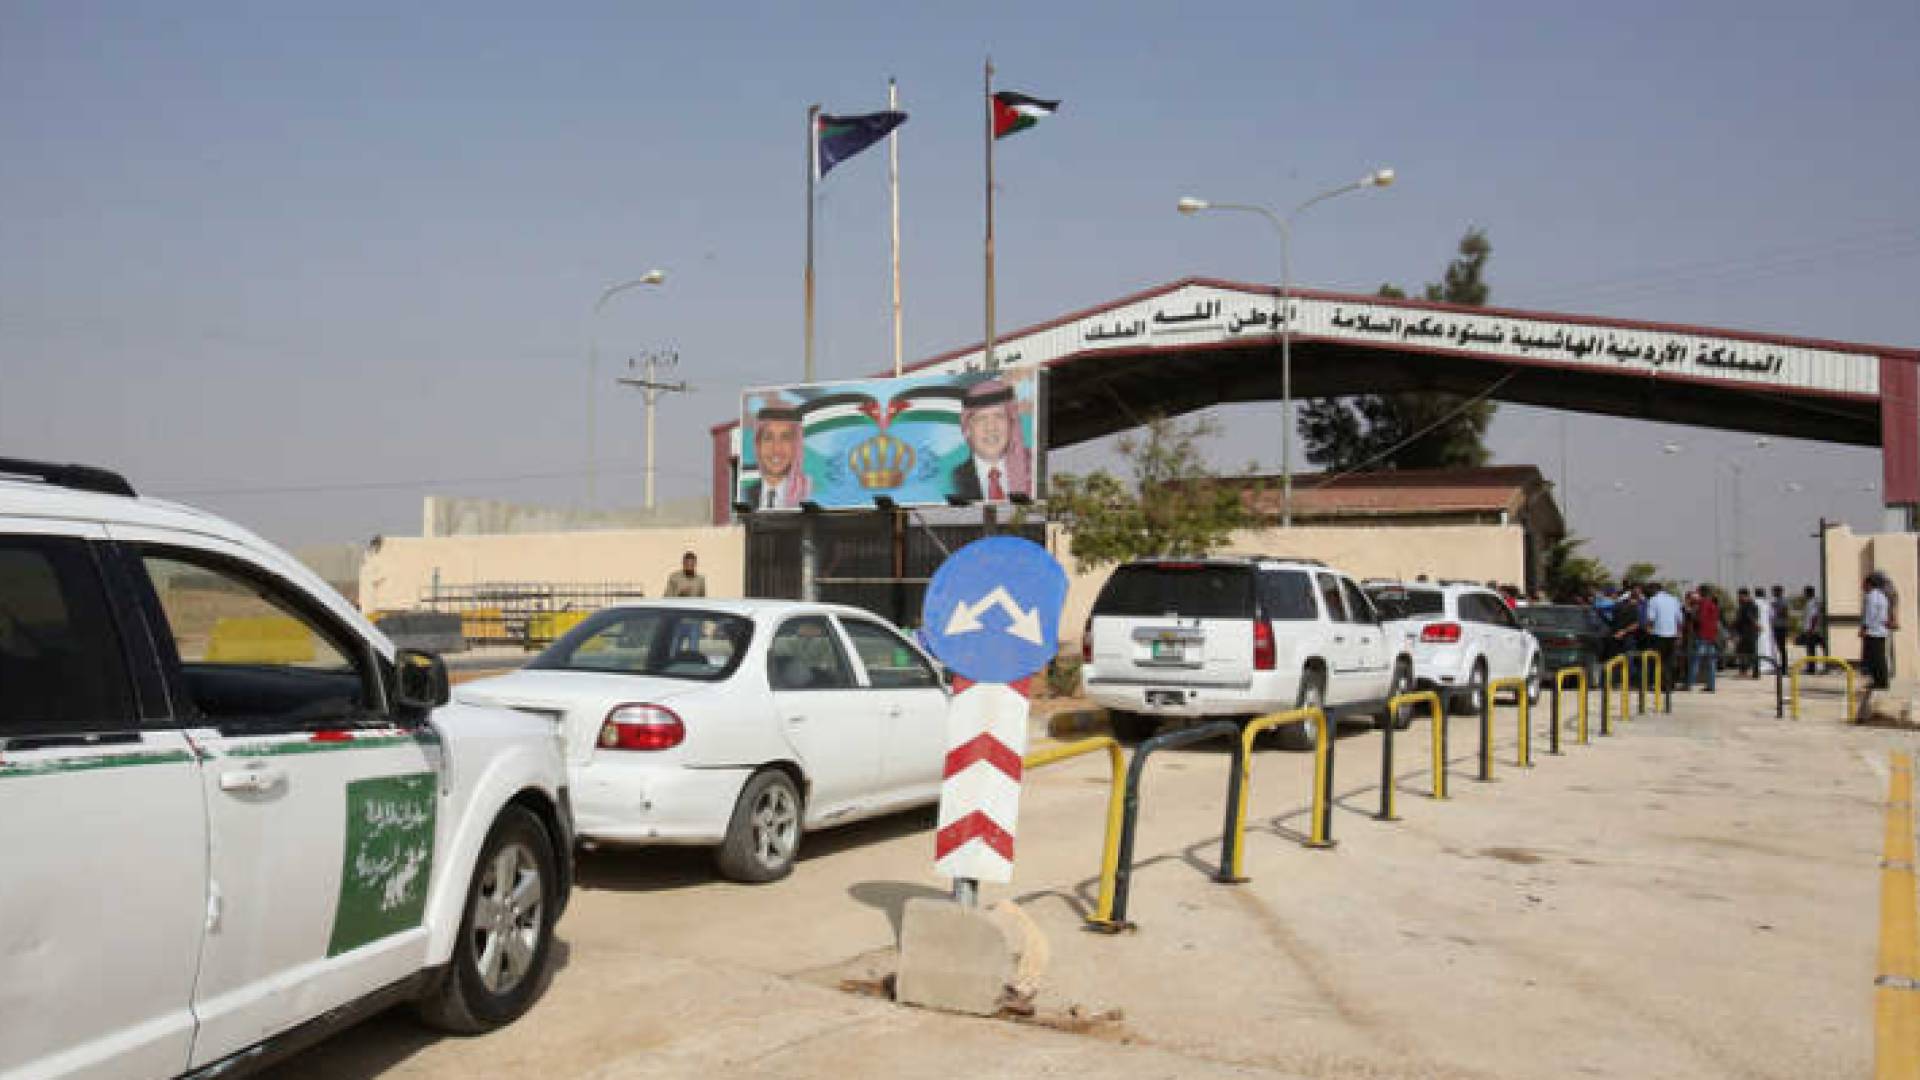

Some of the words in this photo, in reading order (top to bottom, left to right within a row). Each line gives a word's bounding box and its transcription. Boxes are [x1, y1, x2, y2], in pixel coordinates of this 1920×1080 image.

[1154, 299, 1222, 324] الله
[1331, 307, 1402, 333] السلامة
[1085, 320, 1146, 341] الملك
[1511, 325, 1604, 358] الهاشمية
[1695, 342, 1783, 374] المملكة
